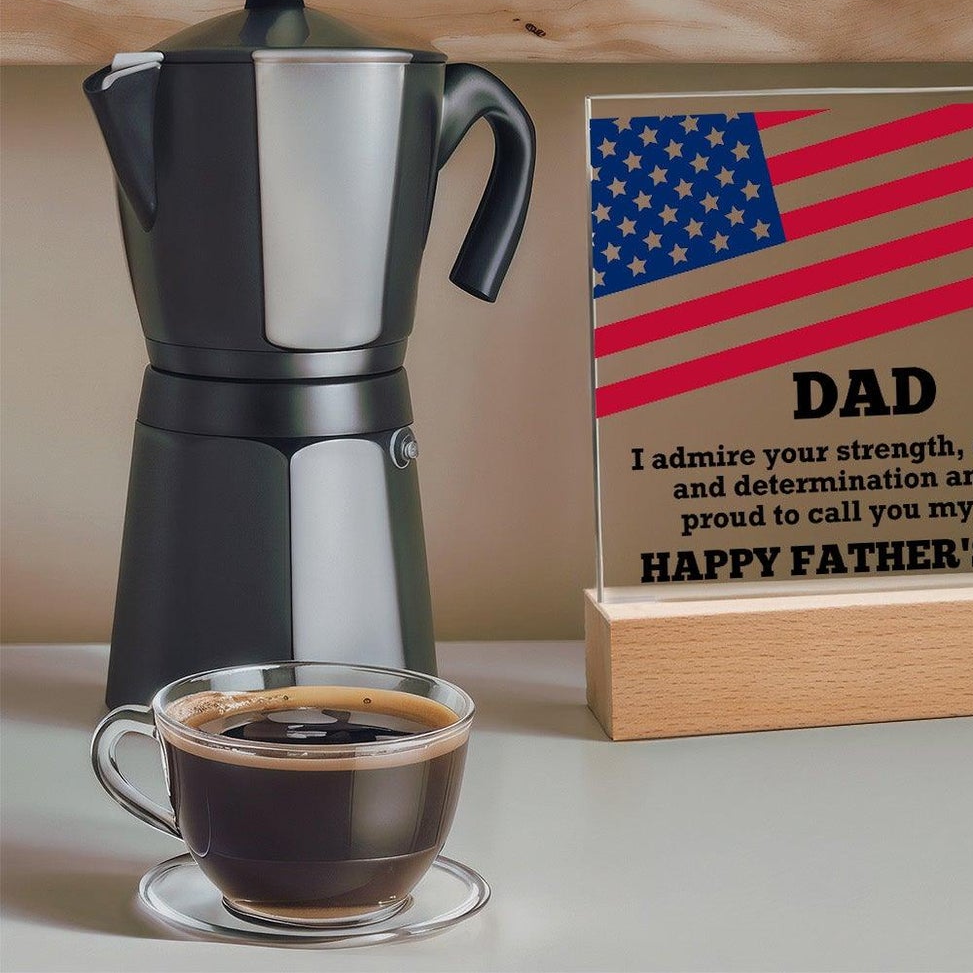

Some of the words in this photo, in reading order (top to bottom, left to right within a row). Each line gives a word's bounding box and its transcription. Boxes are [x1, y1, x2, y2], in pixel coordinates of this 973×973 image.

[792, 366, 937, 420] DAD
[631, 448, 645, 471] I
[651, 444, 756, 470] admire
[762, 445, 829, 471] your
[836, 434, 964, 465] strength,
[673, 475, 727, 500] and
[733, 466, 939, 497] determination
[680, 504, 767, 537] proud
[772, 504, 800, 526] to
[807, 499, 862, 525] call
[868, 502, 921, 528] you
[640, 546, 781, 584] HAPPY
